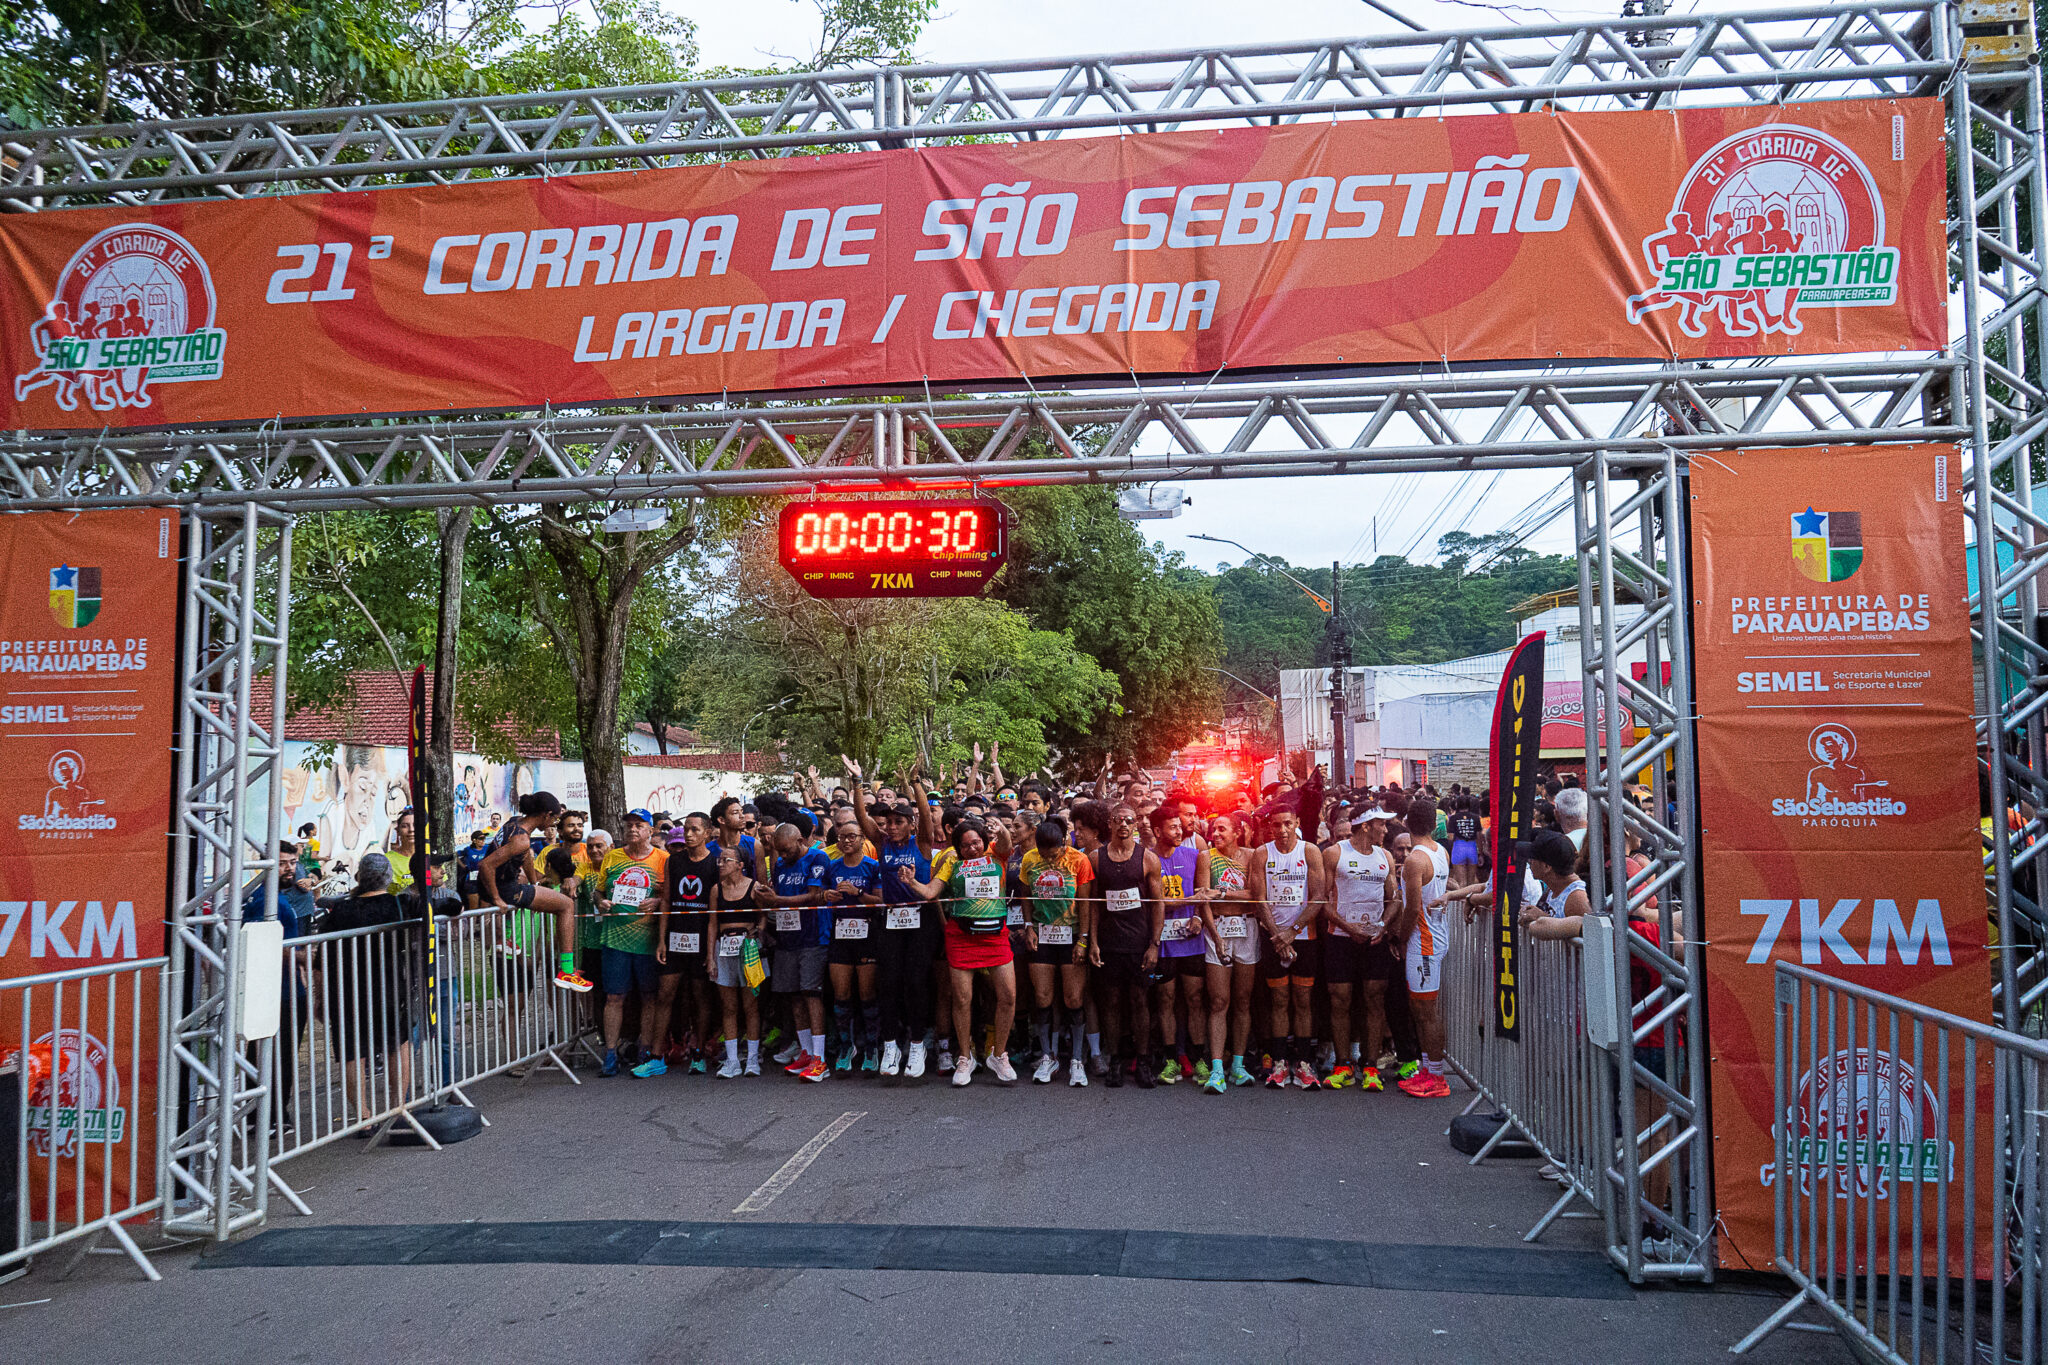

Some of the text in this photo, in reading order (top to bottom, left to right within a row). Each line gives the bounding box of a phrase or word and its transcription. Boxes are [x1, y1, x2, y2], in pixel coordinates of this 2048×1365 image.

[1735, 136, 1818, 163] CORRIDA
[1820, 158, 1849, 182] DE
[266, 153, 1582, 304] 21ª CORRIDA DE SÃO SEBASTIÃO
[103, 234, 168, 258] CORRIDA
[168, 251, 191, 273] DE
[1662, 246, 1894, 291] SÃO SEBASTIÃO
[1801, 288, 1888, 301] PARAUAPEBAS-PA
[574, 280, 1221, 363] LARGADA / CHEGADA
[45, 328, 222, 370] SÃO SEBASTIÃO
[1937, 456, 1945, 500] ASCOM2026
[795, 511, 979, 554] 00:00:30
[932, 550, 988, 561] ChipTiming
[870, 573, 914, 589] 7KM
[1731, 594, 1929, 611] PREFEITURA DE
[1732, 611, 1930, 634] PARAUAPEBAS
[1, 638, 148, 653] PREFEITURA DE
[0, 653, 147, 672] PARAUAPEBAS
[1737, 670, 1931, 692] SEMEL Secretaria Municipal
[1834, 681, 1846, 690] de
[1848, 681, 1886, 692] Esporte
[1896, 681, 1923, 689] Lazer
[0, 705, 70, 724] SEMEL
[1803, 817, 1878, 827] PARÓQUIA
[0, 900, 138, 958] 7KM
[1740, 899, 1953, 966] 7KM
